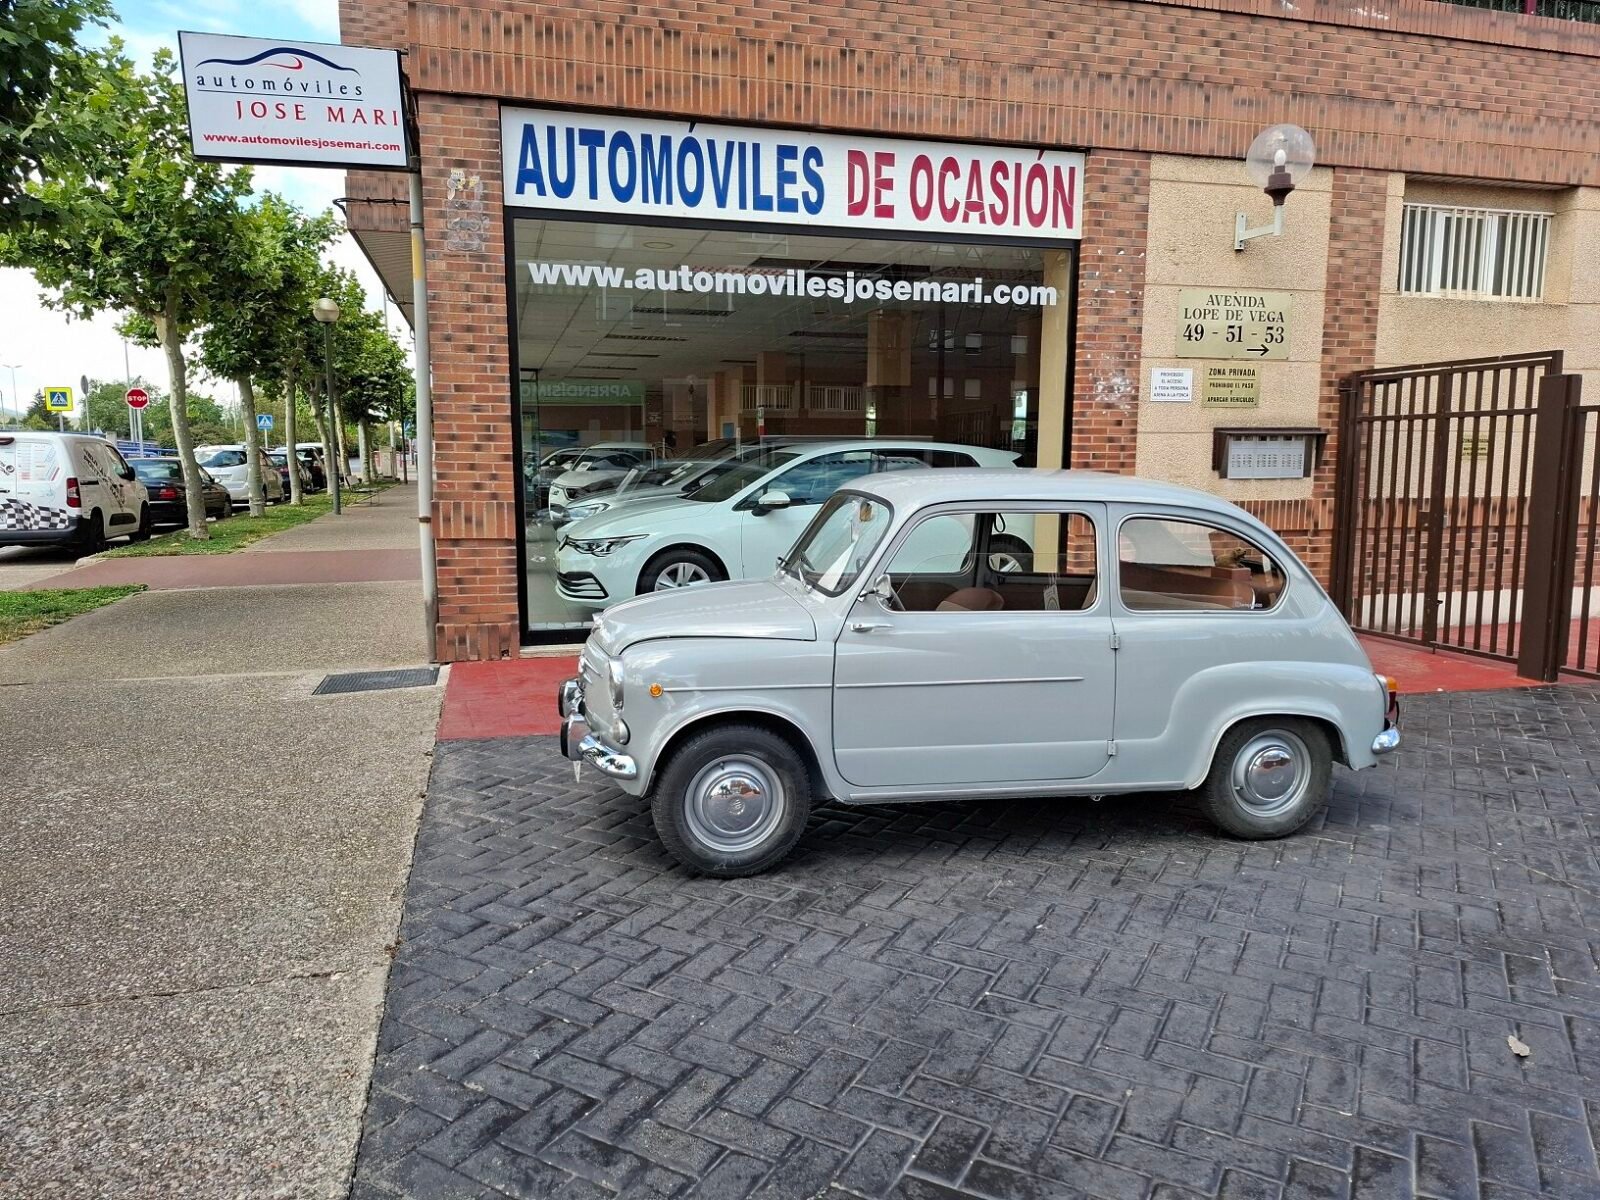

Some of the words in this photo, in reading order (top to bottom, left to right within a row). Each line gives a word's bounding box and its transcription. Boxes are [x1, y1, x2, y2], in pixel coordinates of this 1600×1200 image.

[196, 75, 363, 96] automóviles
[236, 100, 306, 121] JOSE
[327, 106, 399, 126] MARI
[203, 132, 401, 152] www.automovilesjosemari.com
[515, 121, 825, 216] AUTOMÓVILES
[847, 149, 896, 219] DE
[909, 150, 1076, 230] OCASIÓN
[528, 262, 1057, 306] www.automovilesjosemari.com
[1205, 294, 1266, 308] AVENIDA
[1183, 308, 1220, 321] LOPE
[1225, 309, 1244, 322] DE
[1249, 310, 1285, 323] VEGA
[1183, 323, 1205, 342] 49
[1225, 325, 1244, 343] 51
[1264, 326, 1285, 344] 53
[1208, 368, 1227, 377] ZONA
[1228, 368, 1256, 377] PRIVADA
